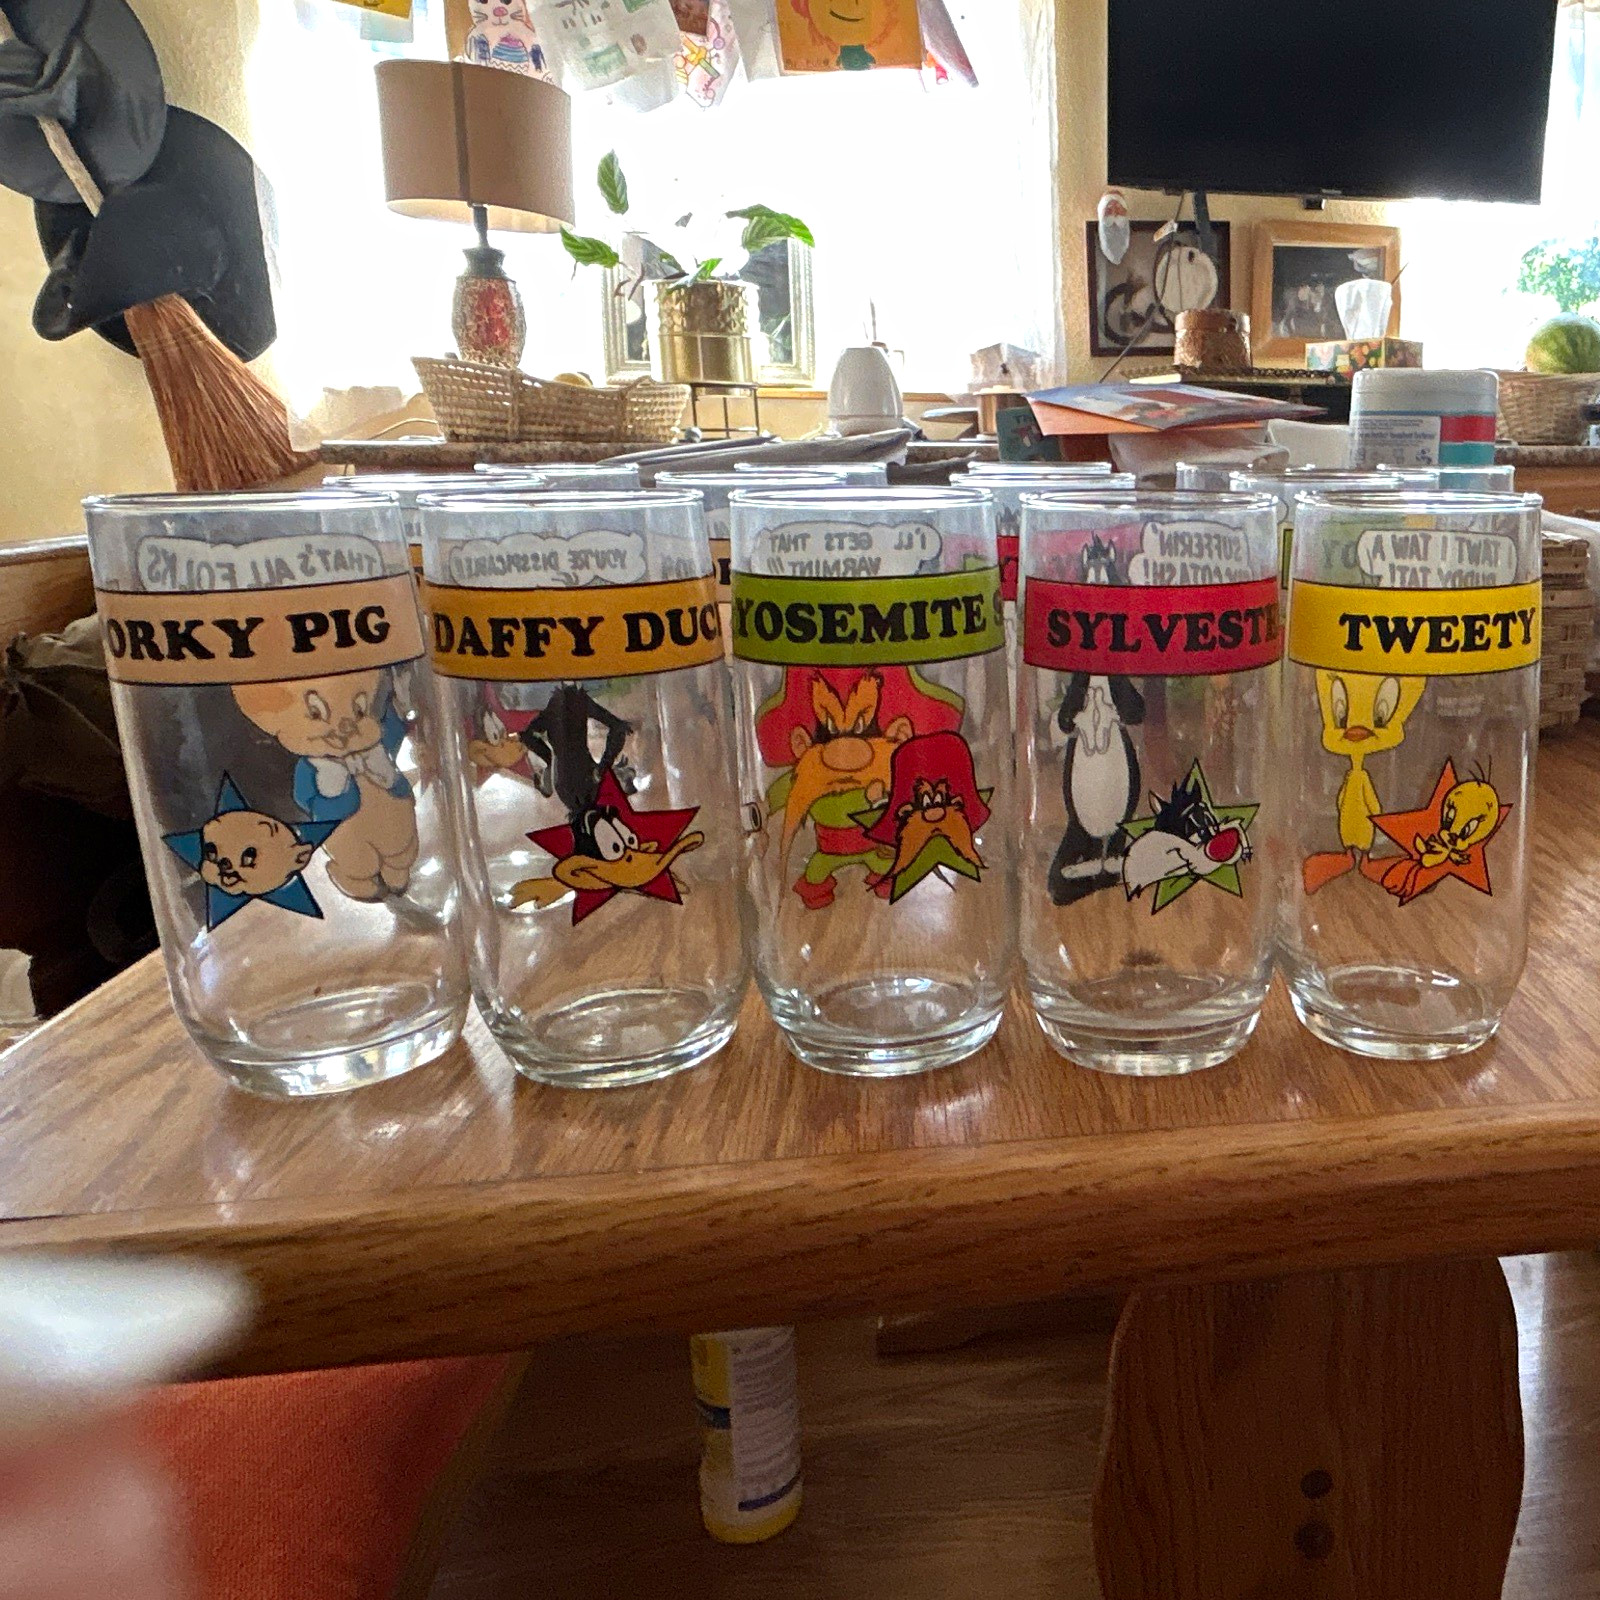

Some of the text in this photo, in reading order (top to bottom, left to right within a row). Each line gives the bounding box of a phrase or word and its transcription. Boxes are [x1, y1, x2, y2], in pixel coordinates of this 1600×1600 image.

[106, 605, 390, 660] ORKY PIG
[433, 603, 721, 657] DAFFY DUC
[736, 594, 987, 644] YOSEMITE
[1338, 607, 1536, 653] TWEETY
